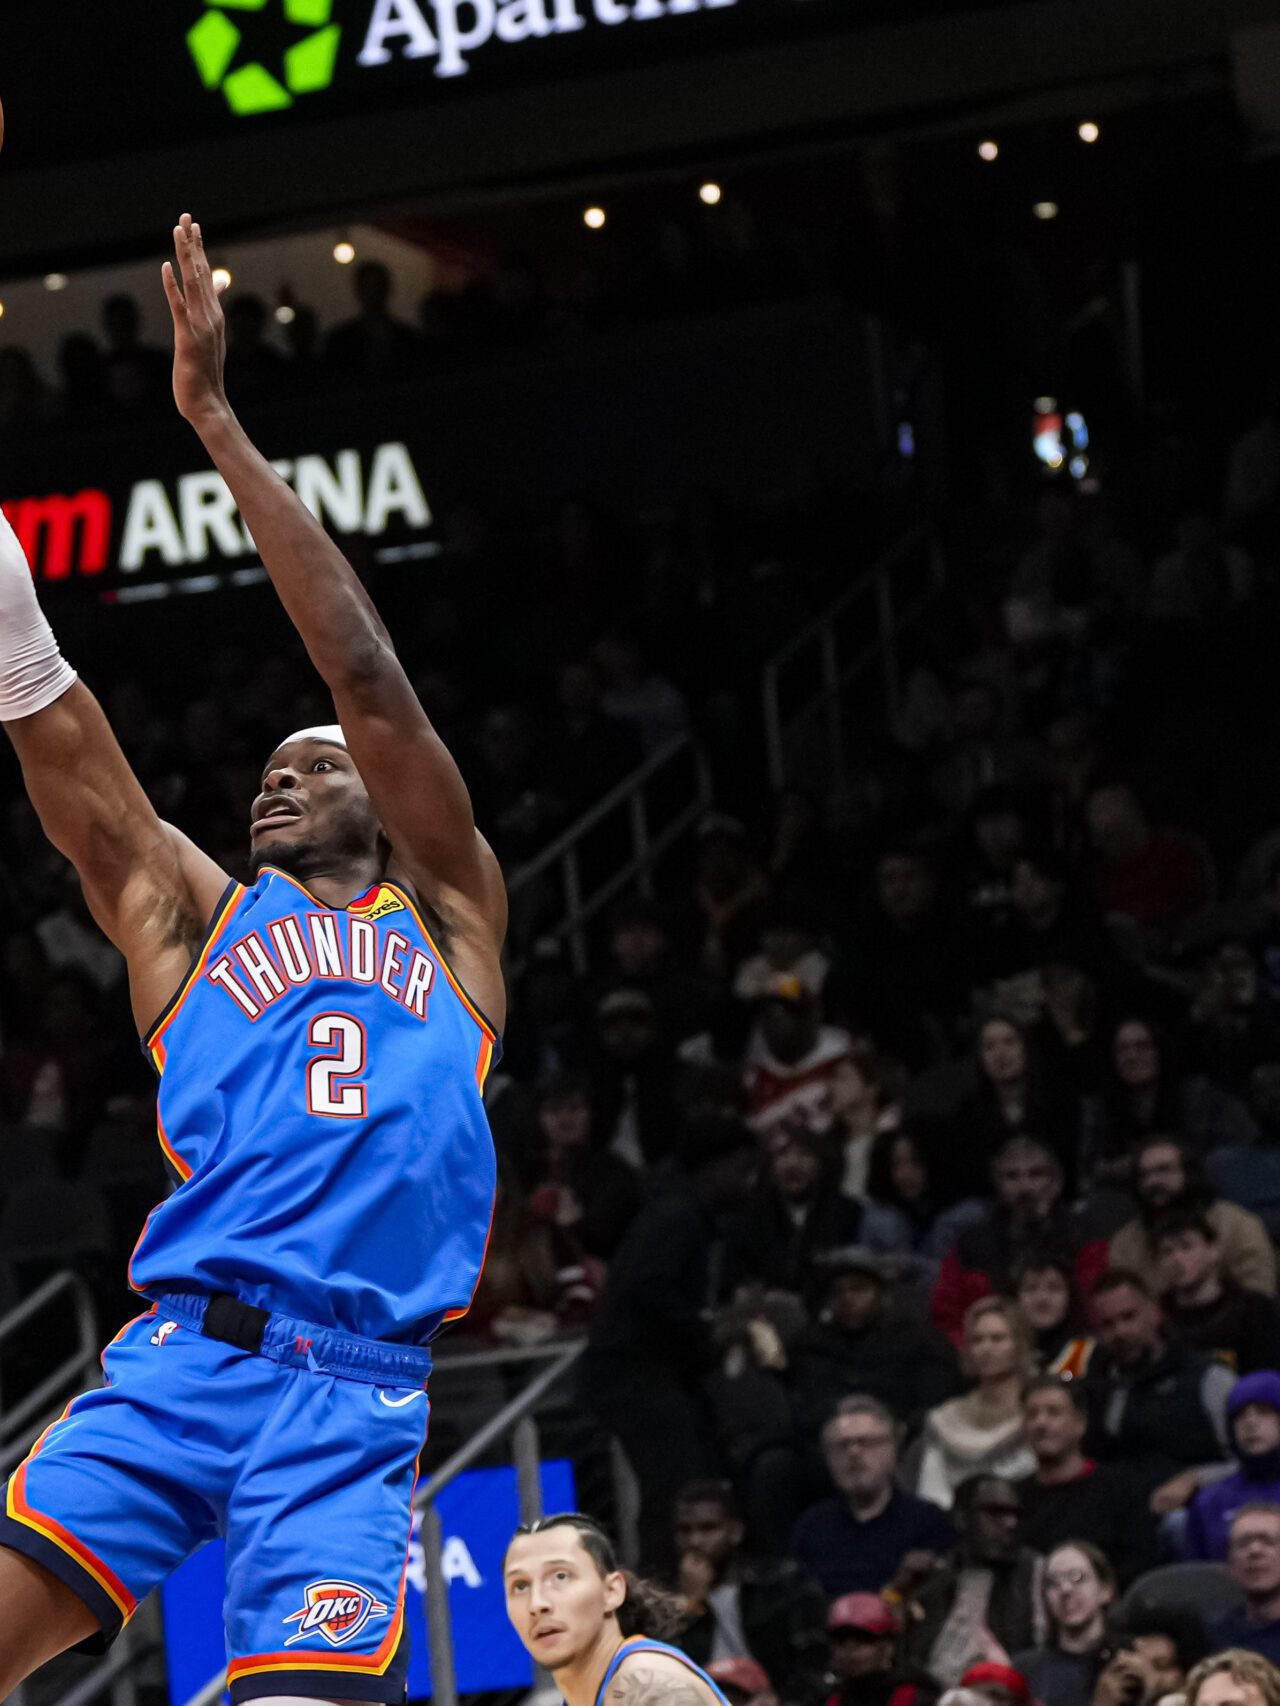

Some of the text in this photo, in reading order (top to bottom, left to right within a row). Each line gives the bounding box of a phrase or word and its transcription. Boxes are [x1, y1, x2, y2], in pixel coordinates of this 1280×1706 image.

[205, 913, 436, 1023] THUNDER
[306, 1011, 368, 1118] 2
[302, 1597, 361, 1629] OKC
